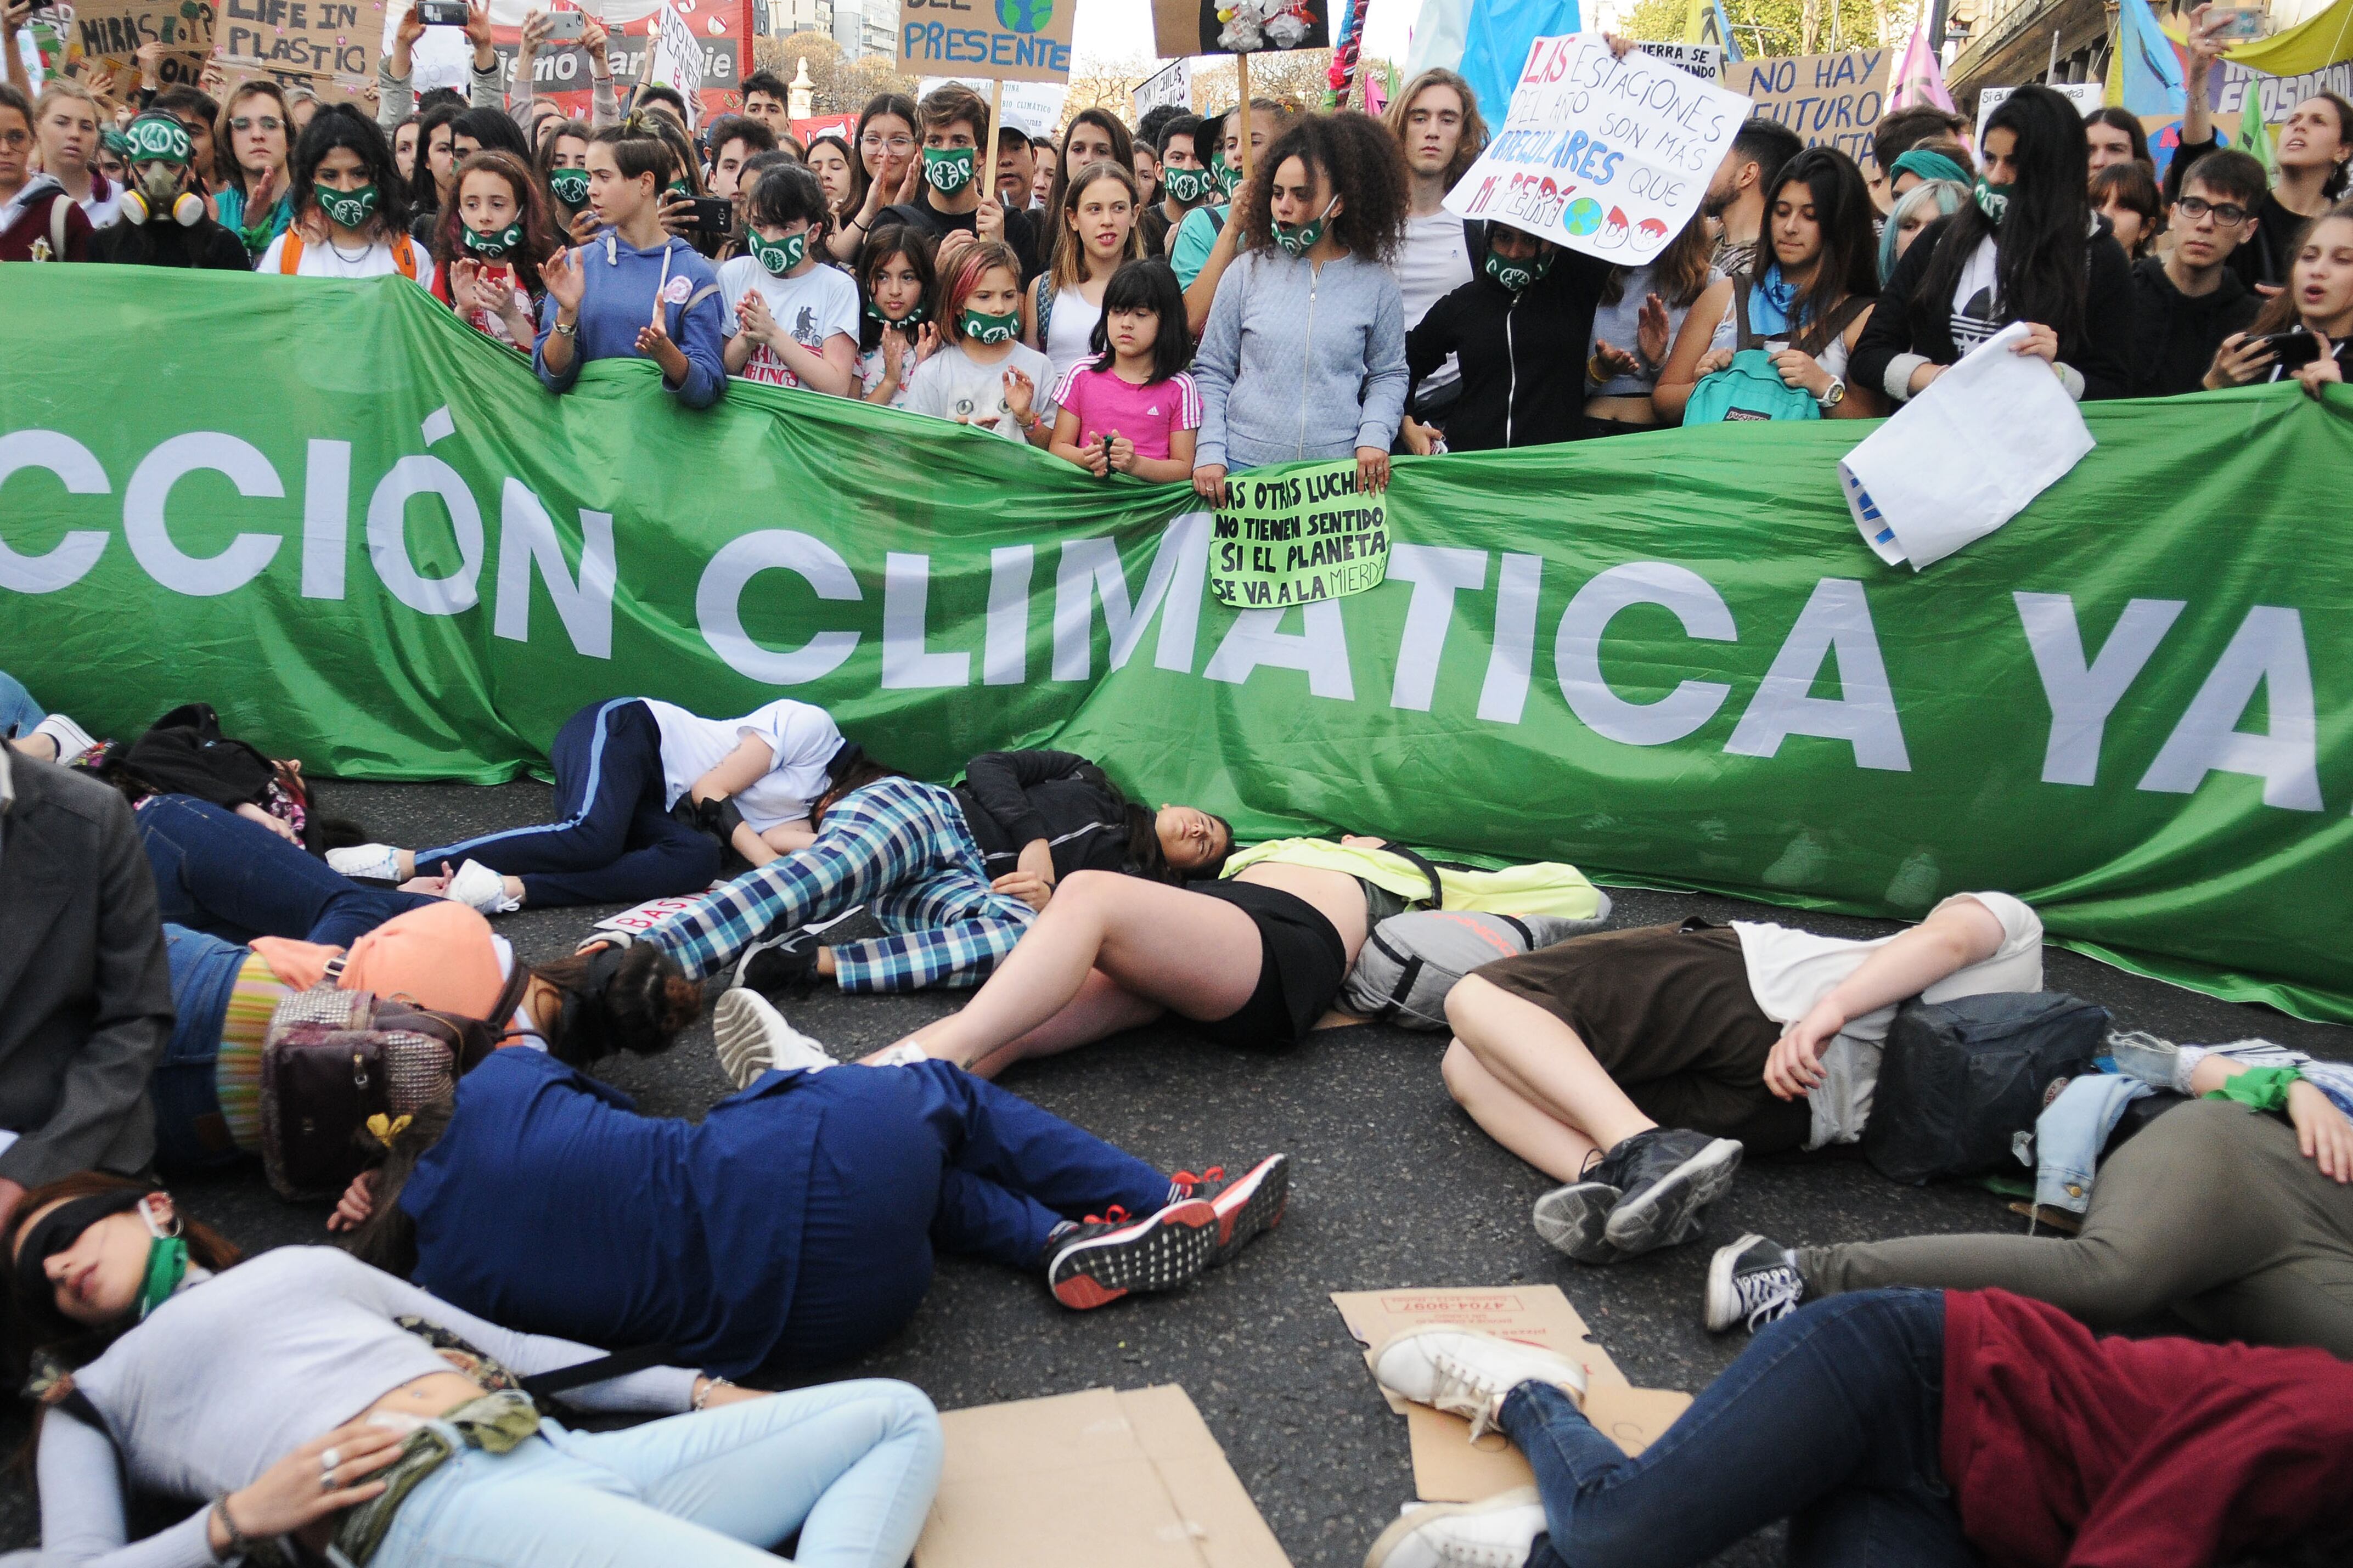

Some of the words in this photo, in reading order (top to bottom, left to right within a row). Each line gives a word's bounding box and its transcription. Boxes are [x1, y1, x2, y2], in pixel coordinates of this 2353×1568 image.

[228, 0, 307, 29] LIFE
[317, 3, 357, 29] IN
[229, 26, 365, 74] PLASTIC
[666, 7, 684, 43] NO
[685, 35, 703, 77] HAY
[904, 21, 1071, 72] PRESENTE
[1523, 36, 1575, 83] LAS
[1639, 44, 1683, 59] IERRA
[1691, 48, 1710, 64] SE
[673, 67, 681, 91] B
[1749, 61, 1796, 97] NO
[1815, 50, 1882, 88] HAY
[1507, 89, 1539, 124] DEL
[1550, 91, 1590, 121] AÑO
[1599, 113, 1650, 148] SON
[1654, 137, 1707, 171] MÁS
[1489, 129, 1624, 185] IRREGULARES
[1628, 167, 1685, 207] QUE
[1224, 482, 1246, 511] AS
[1254, 477, 1302, 510] OTRAS
[1305, 469, 1370, 504] LUCH
[1214, 514, 1239, 539] NO
[1243, 515, 1301, 542] TIENEN
[1307, 506, 1384, 536] SENTIDO
[1221, 542, 1243, 573] SI
[1253, 546, 1276, 573] EL
[1287, 530, 1386, 572] PLANETA
[1212, 578, 1236, 602] SE
[1242, 580, 1273, 605] VA
[1296, 575, 1327, 602] LA
